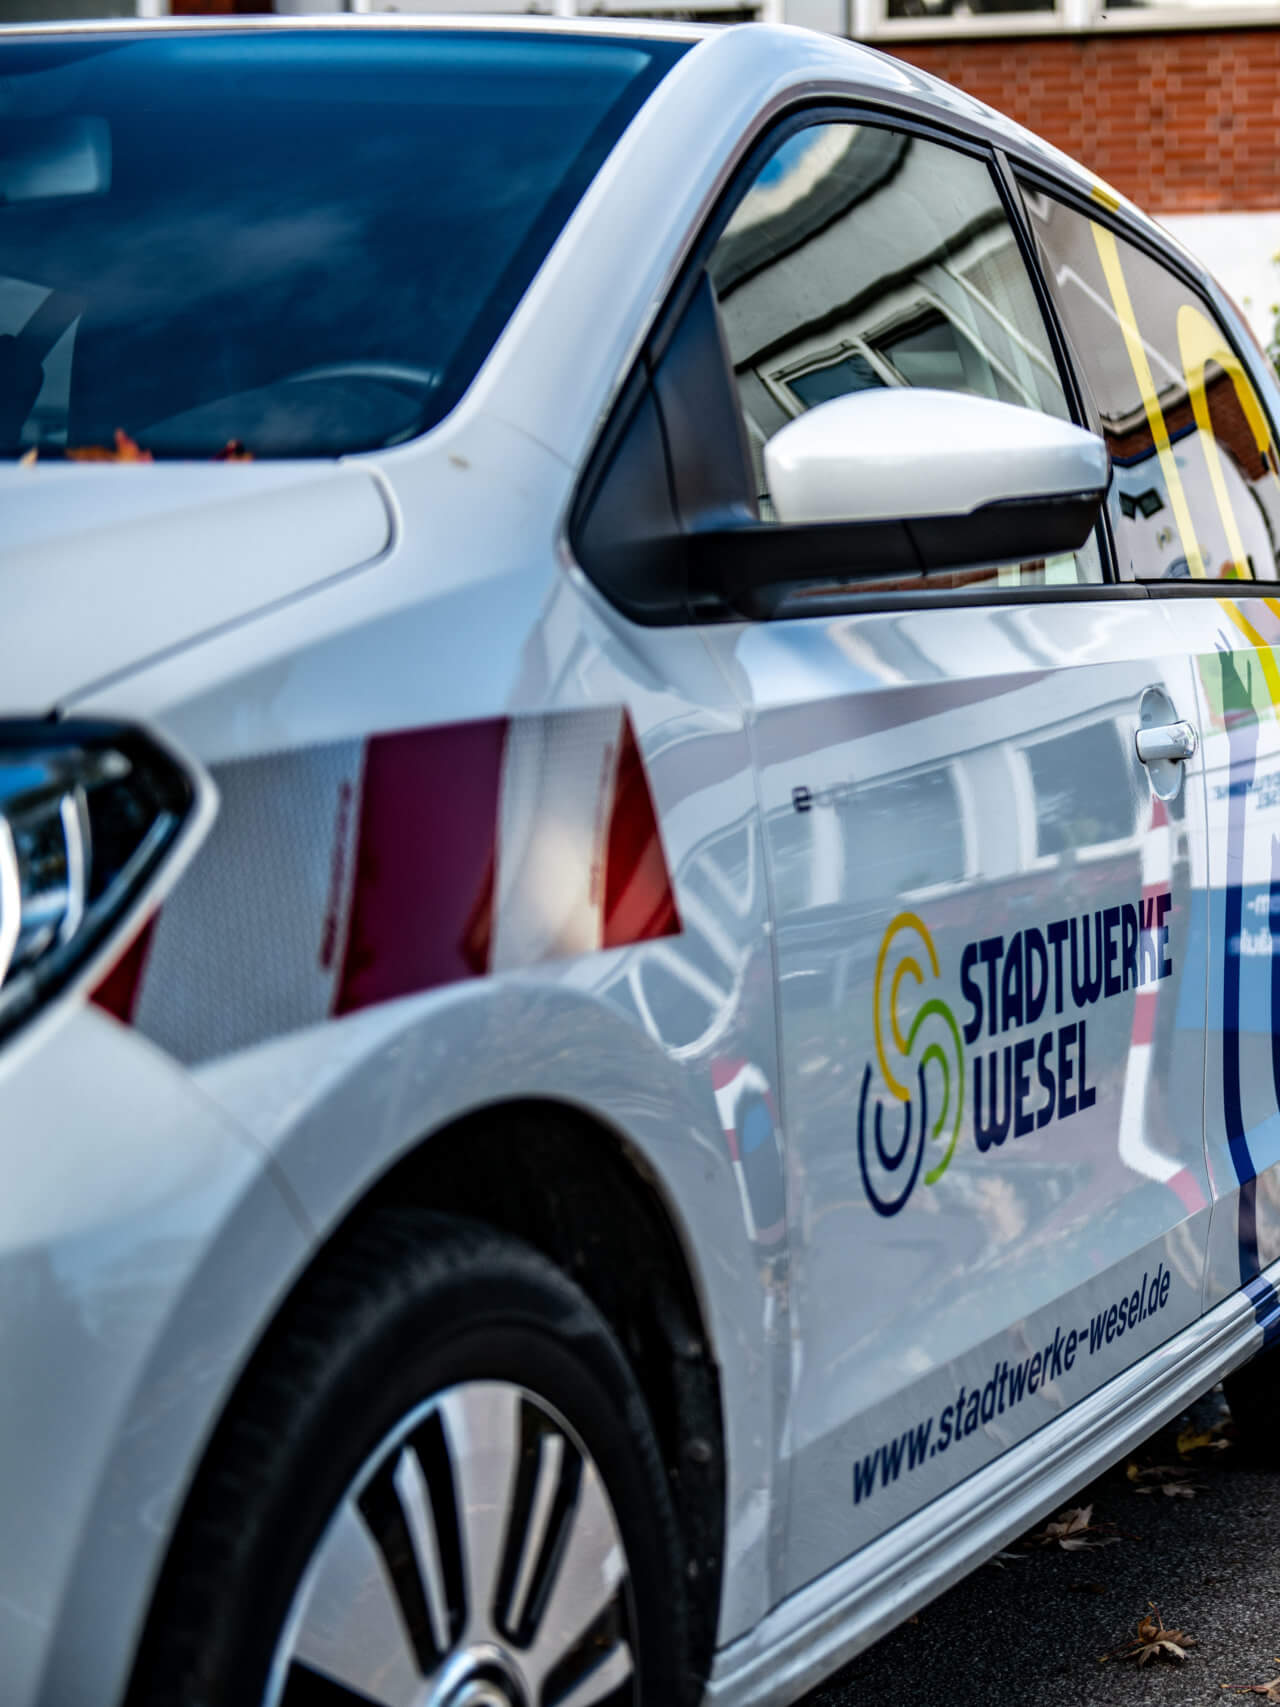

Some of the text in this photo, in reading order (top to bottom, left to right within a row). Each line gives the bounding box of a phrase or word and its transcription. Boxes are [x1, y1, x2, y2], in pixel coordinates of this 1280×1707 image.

[959, 892, 1173, 1045] STADTWERKE
[973, 1019, 1097, 1154] WESEL
[853, 1262, 1171, 1505] www.stadtwerke-wesel.de
